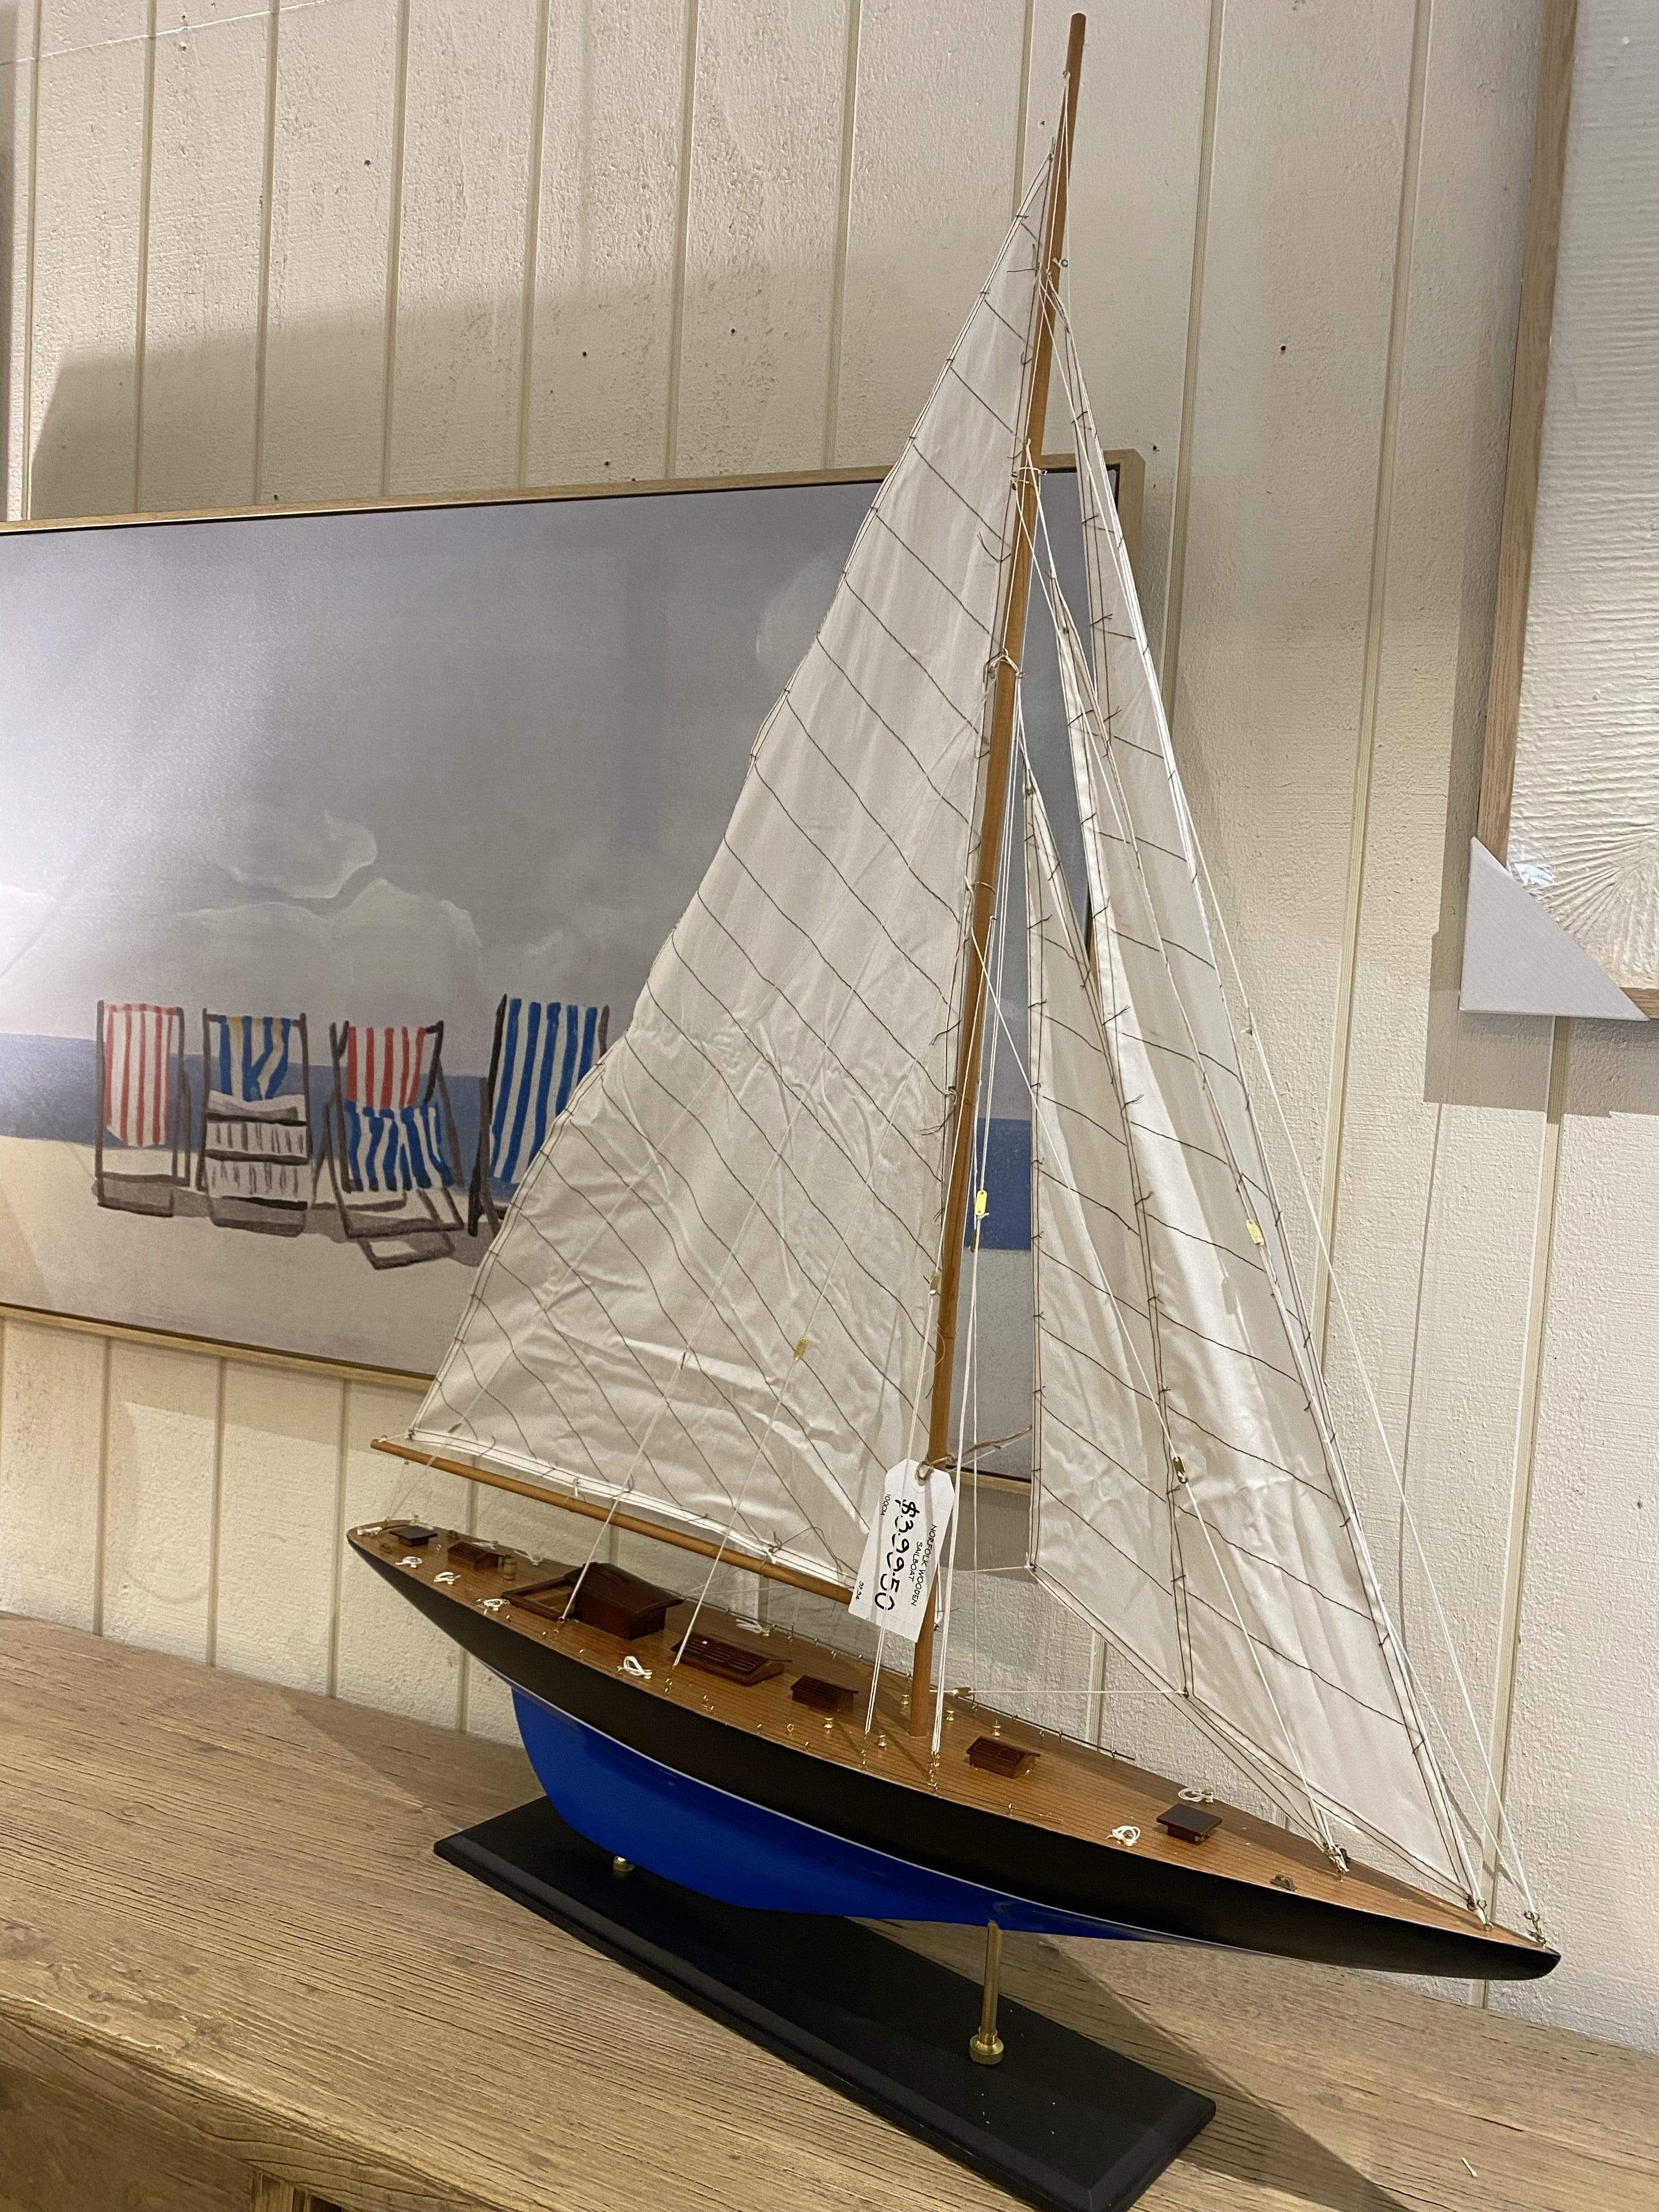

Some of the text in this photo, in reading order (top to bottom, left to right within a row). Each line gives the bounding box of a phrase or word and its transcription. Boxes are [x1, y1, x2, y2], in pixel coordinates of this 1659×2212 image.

[908, 1541, 922, 1582] SAILBOAT
[911, 1524, 937, 1606] NORFOLK WOODEN
